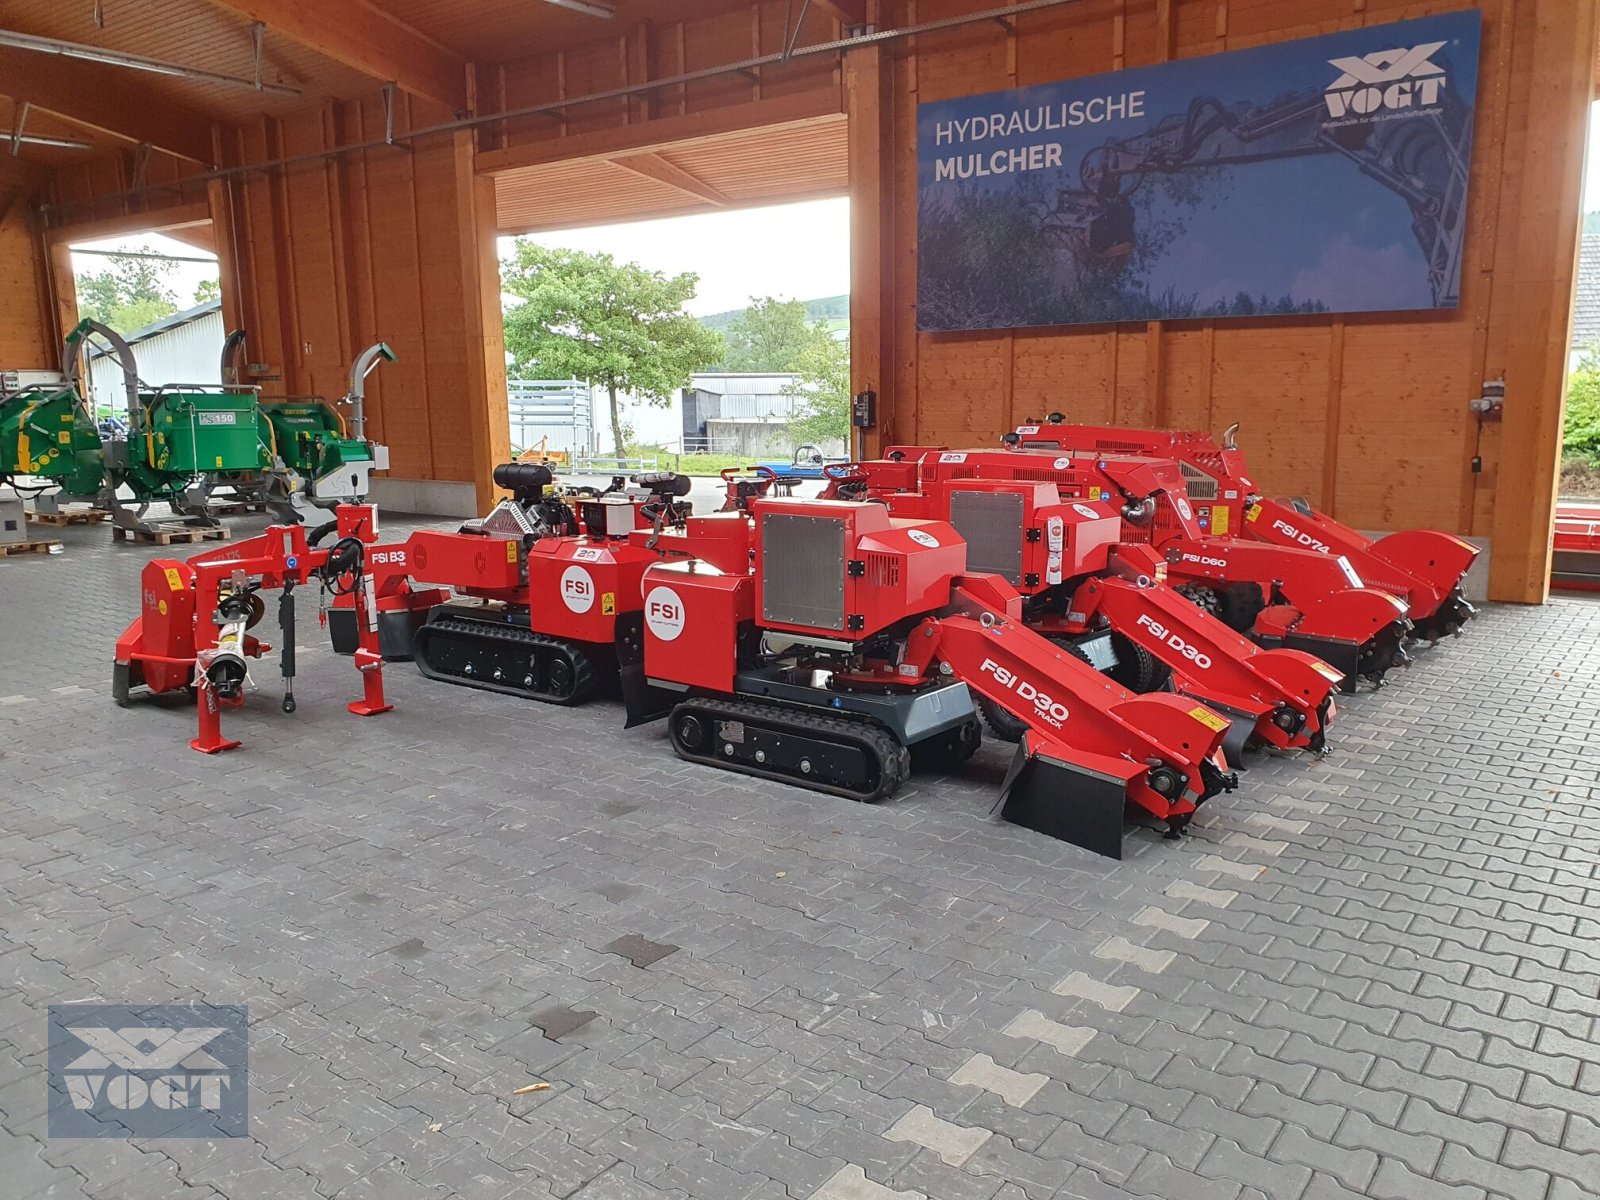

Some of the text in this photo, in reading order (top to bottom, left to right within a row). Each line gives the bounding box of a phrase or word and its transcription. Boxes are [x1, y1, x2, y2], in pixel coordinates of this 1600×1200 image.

[1325, 76, 1446, 118] VOGT
[936, 91, 1145, 146] HYDRAULISCHE
[936, 143, 1063, 181] MULCHER
[215, 413, 233, 423] 150
[1272, 519, 1330, 555] FSI D74
[371, 552, 389, 564] FSI
[1182, 553, 1227, 567] FSI D60
[565, 580, 590, 595] FSI
[650, 602, 679, 620] FSI
[1136, 614, 1212, 670] FSI D30
[979, 658, 1070, 722] FSI D30
[1033, 707, 1063, 730] TRACK
